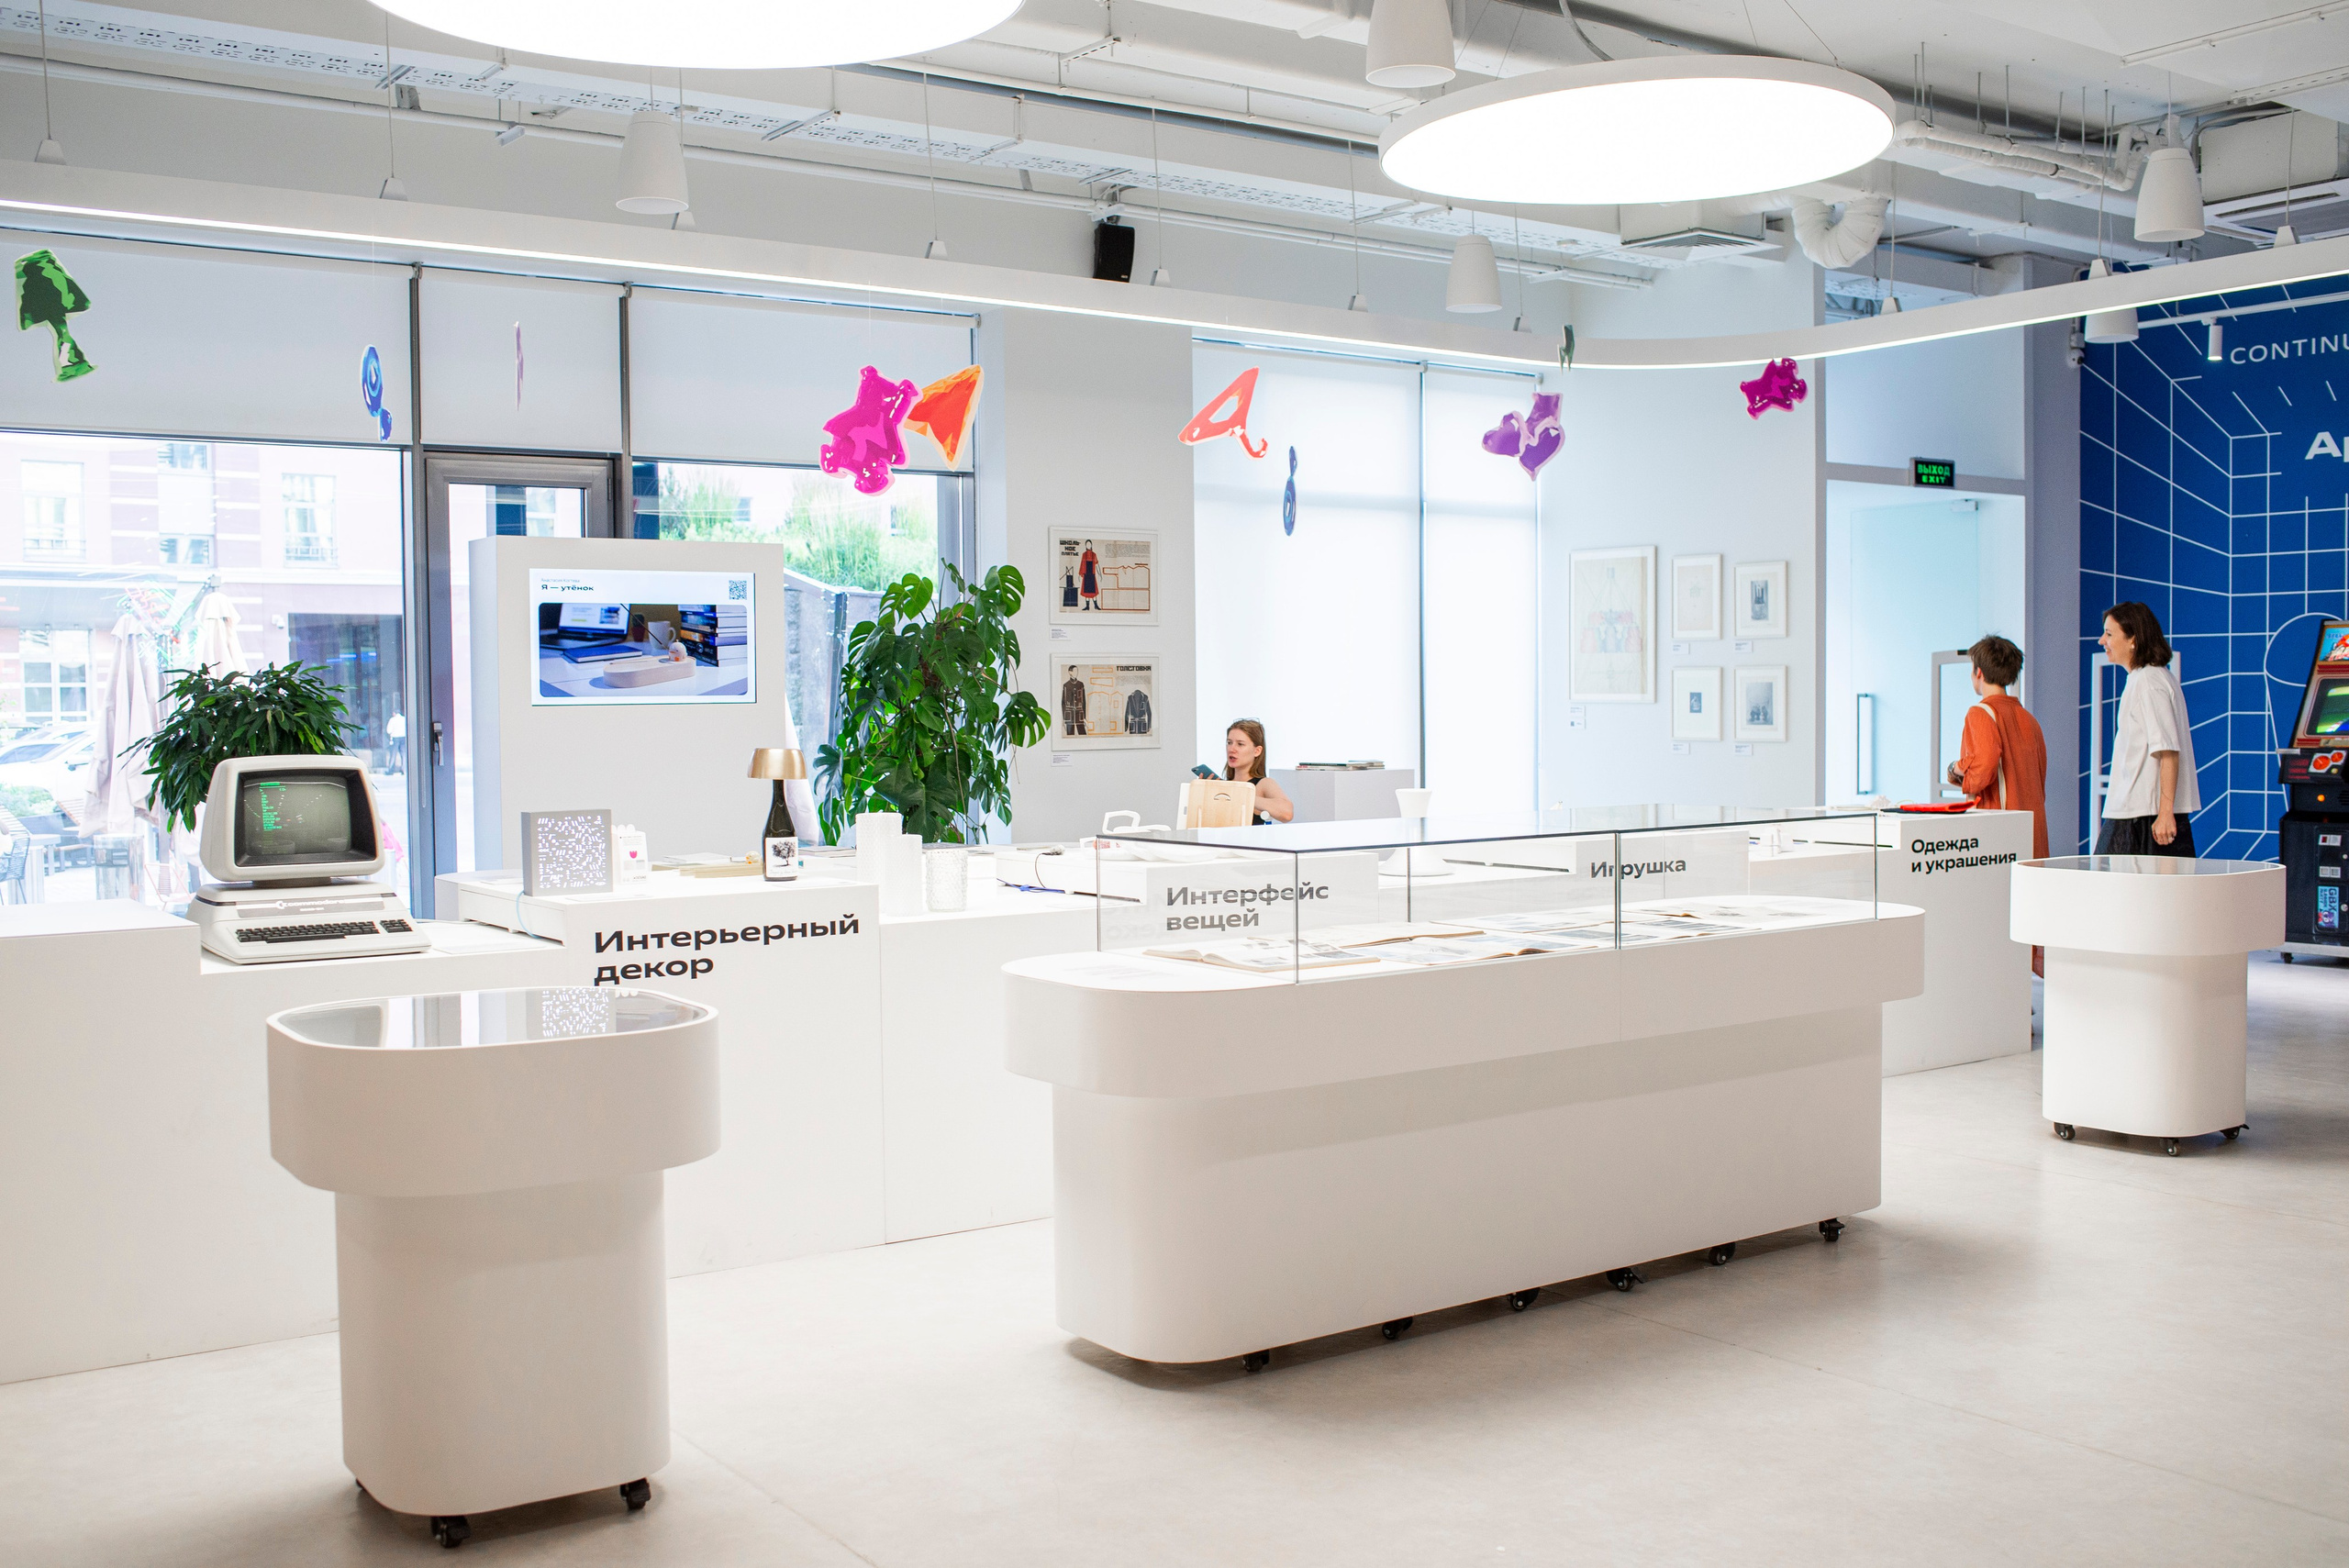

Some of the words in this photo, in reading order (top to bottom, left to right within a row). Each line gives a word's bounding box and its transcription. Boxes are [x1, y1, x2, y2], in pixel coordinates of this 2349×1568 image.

[1917, 463, 1951, 477] ВЫХОД
[1921, 474, 1946, 484] EXIT
[1911, 837, 1979, 856] Одежда
[1590, 860, 1687, 880] Игрушка
[1911, 861, 1921, 873] и
[1925, 853, 2017, 874] украшения
[1166, 881, 1329, 906] Интерфейс
[1166, 907, 1259, 931] вещей
[595, 913, 860, 953] Интерьерный
[594, 958, 715, 986] декор
